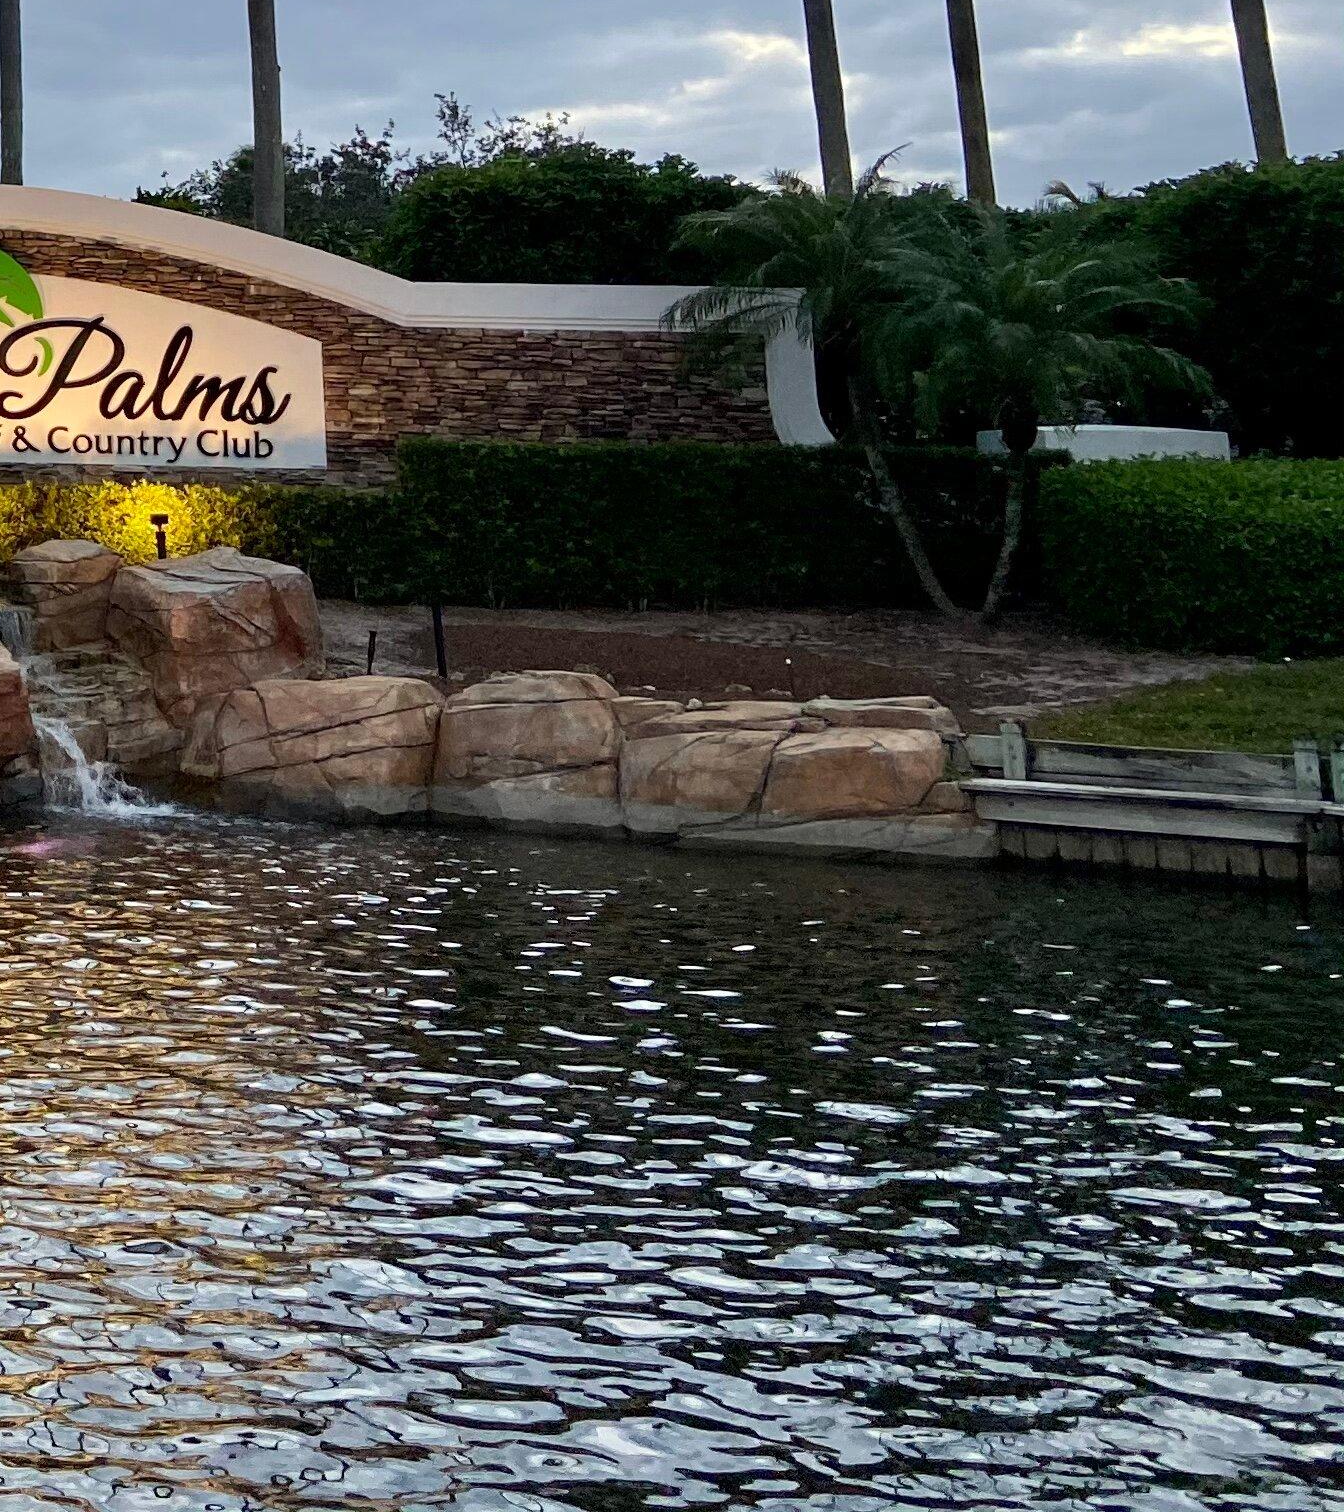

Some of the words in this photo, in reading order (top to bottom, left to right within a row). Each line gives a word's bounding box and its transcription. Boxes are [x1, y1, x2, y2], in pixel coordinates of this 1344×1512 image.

[11, 425, 42, 454] &
[47, 426, 187, 463] Country
[197, 428, 274, 460] Club
